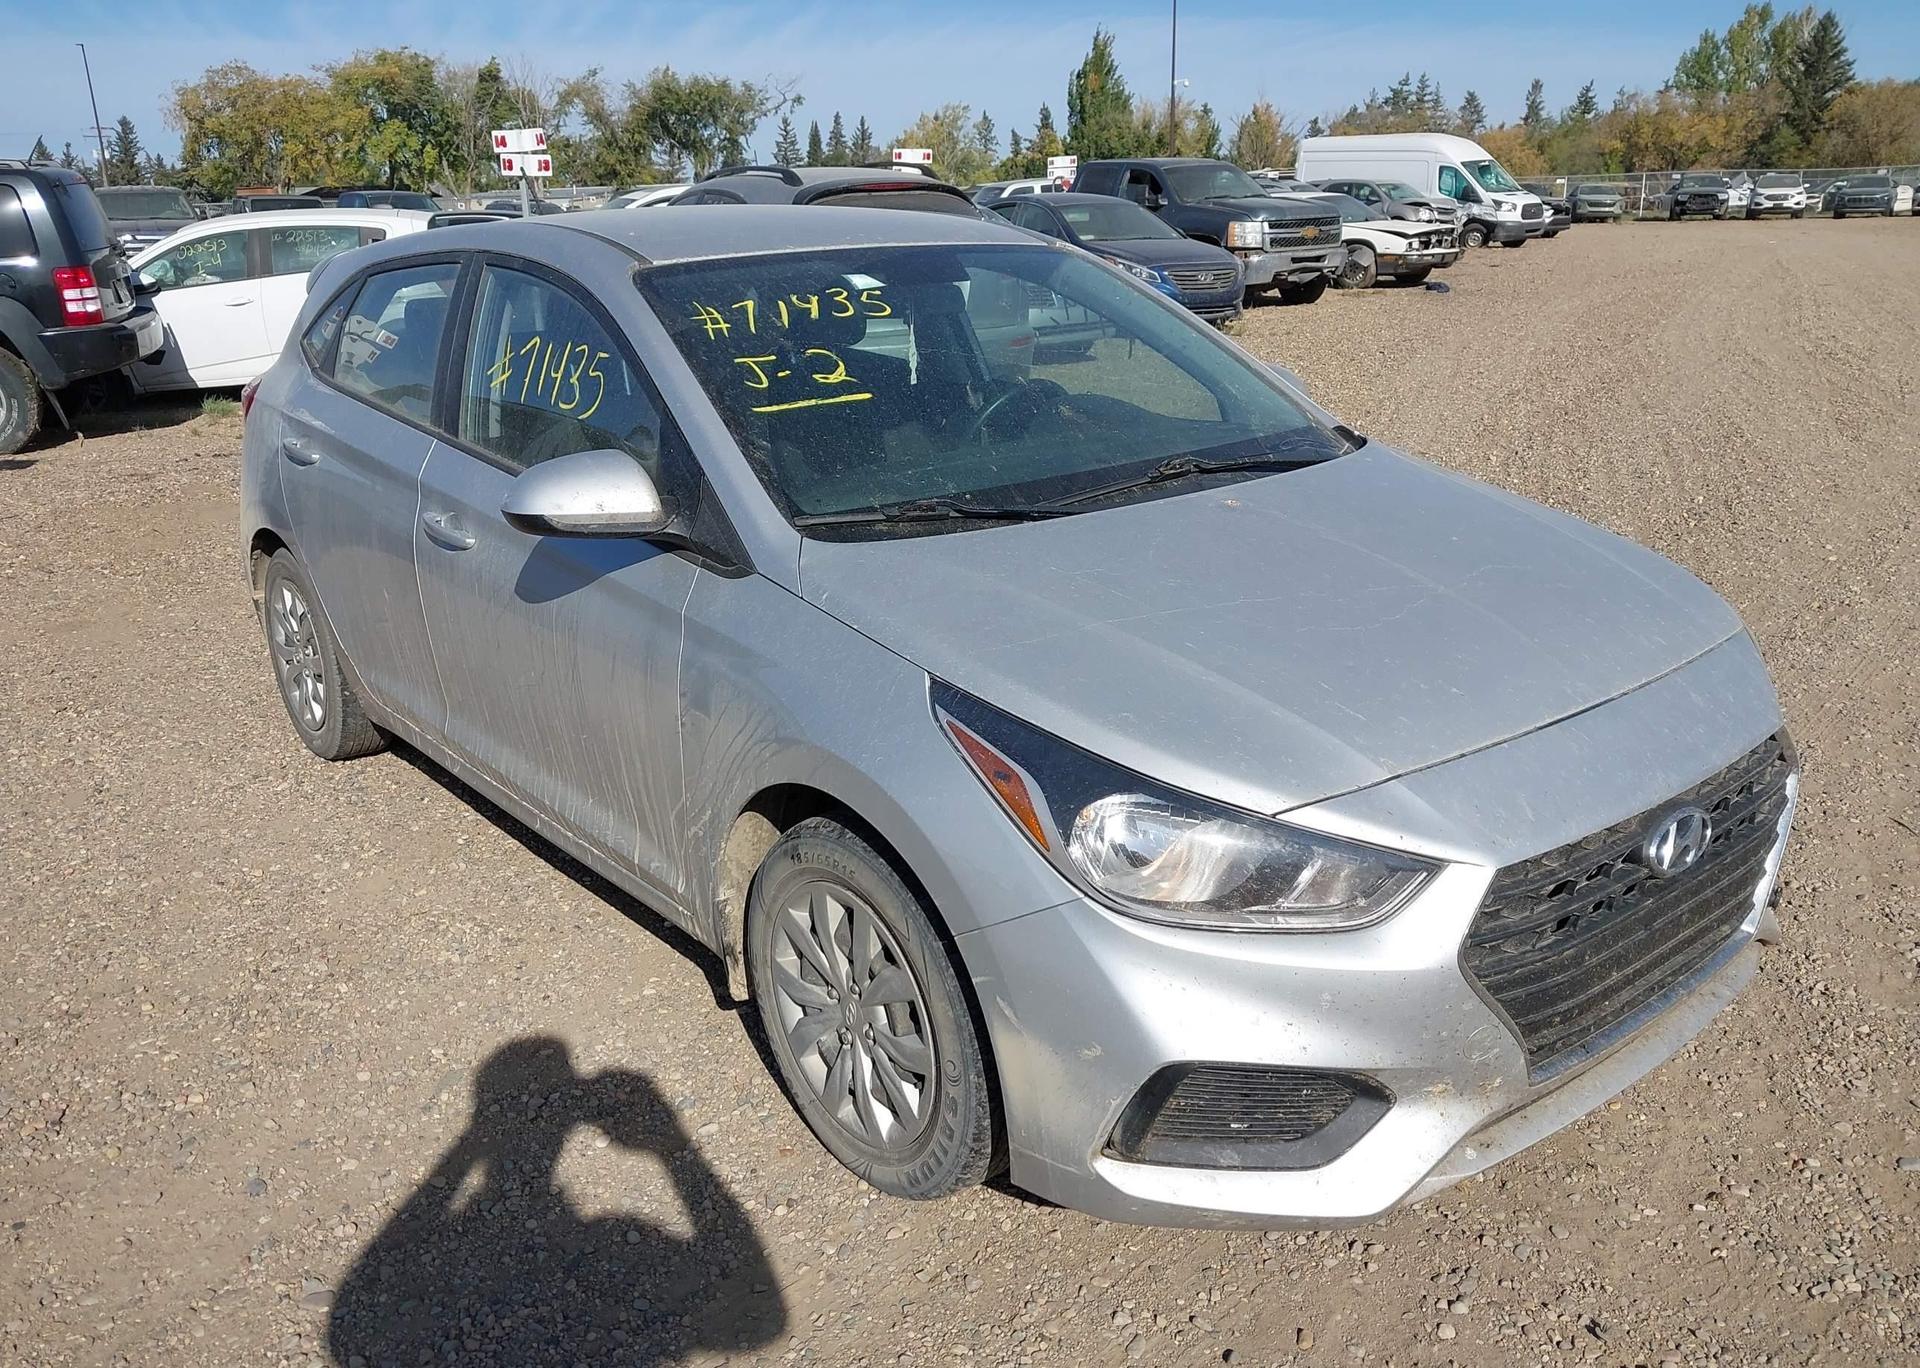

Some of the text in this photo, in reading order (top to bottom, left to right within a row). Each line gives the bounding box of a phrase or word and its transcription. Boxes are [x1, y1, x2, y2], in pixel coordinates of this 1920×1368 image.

[689, 287, 893, 341] #71435
[486, 334, 610, 420] #71435
[903, 1090, 959, 1188] SAILUN
